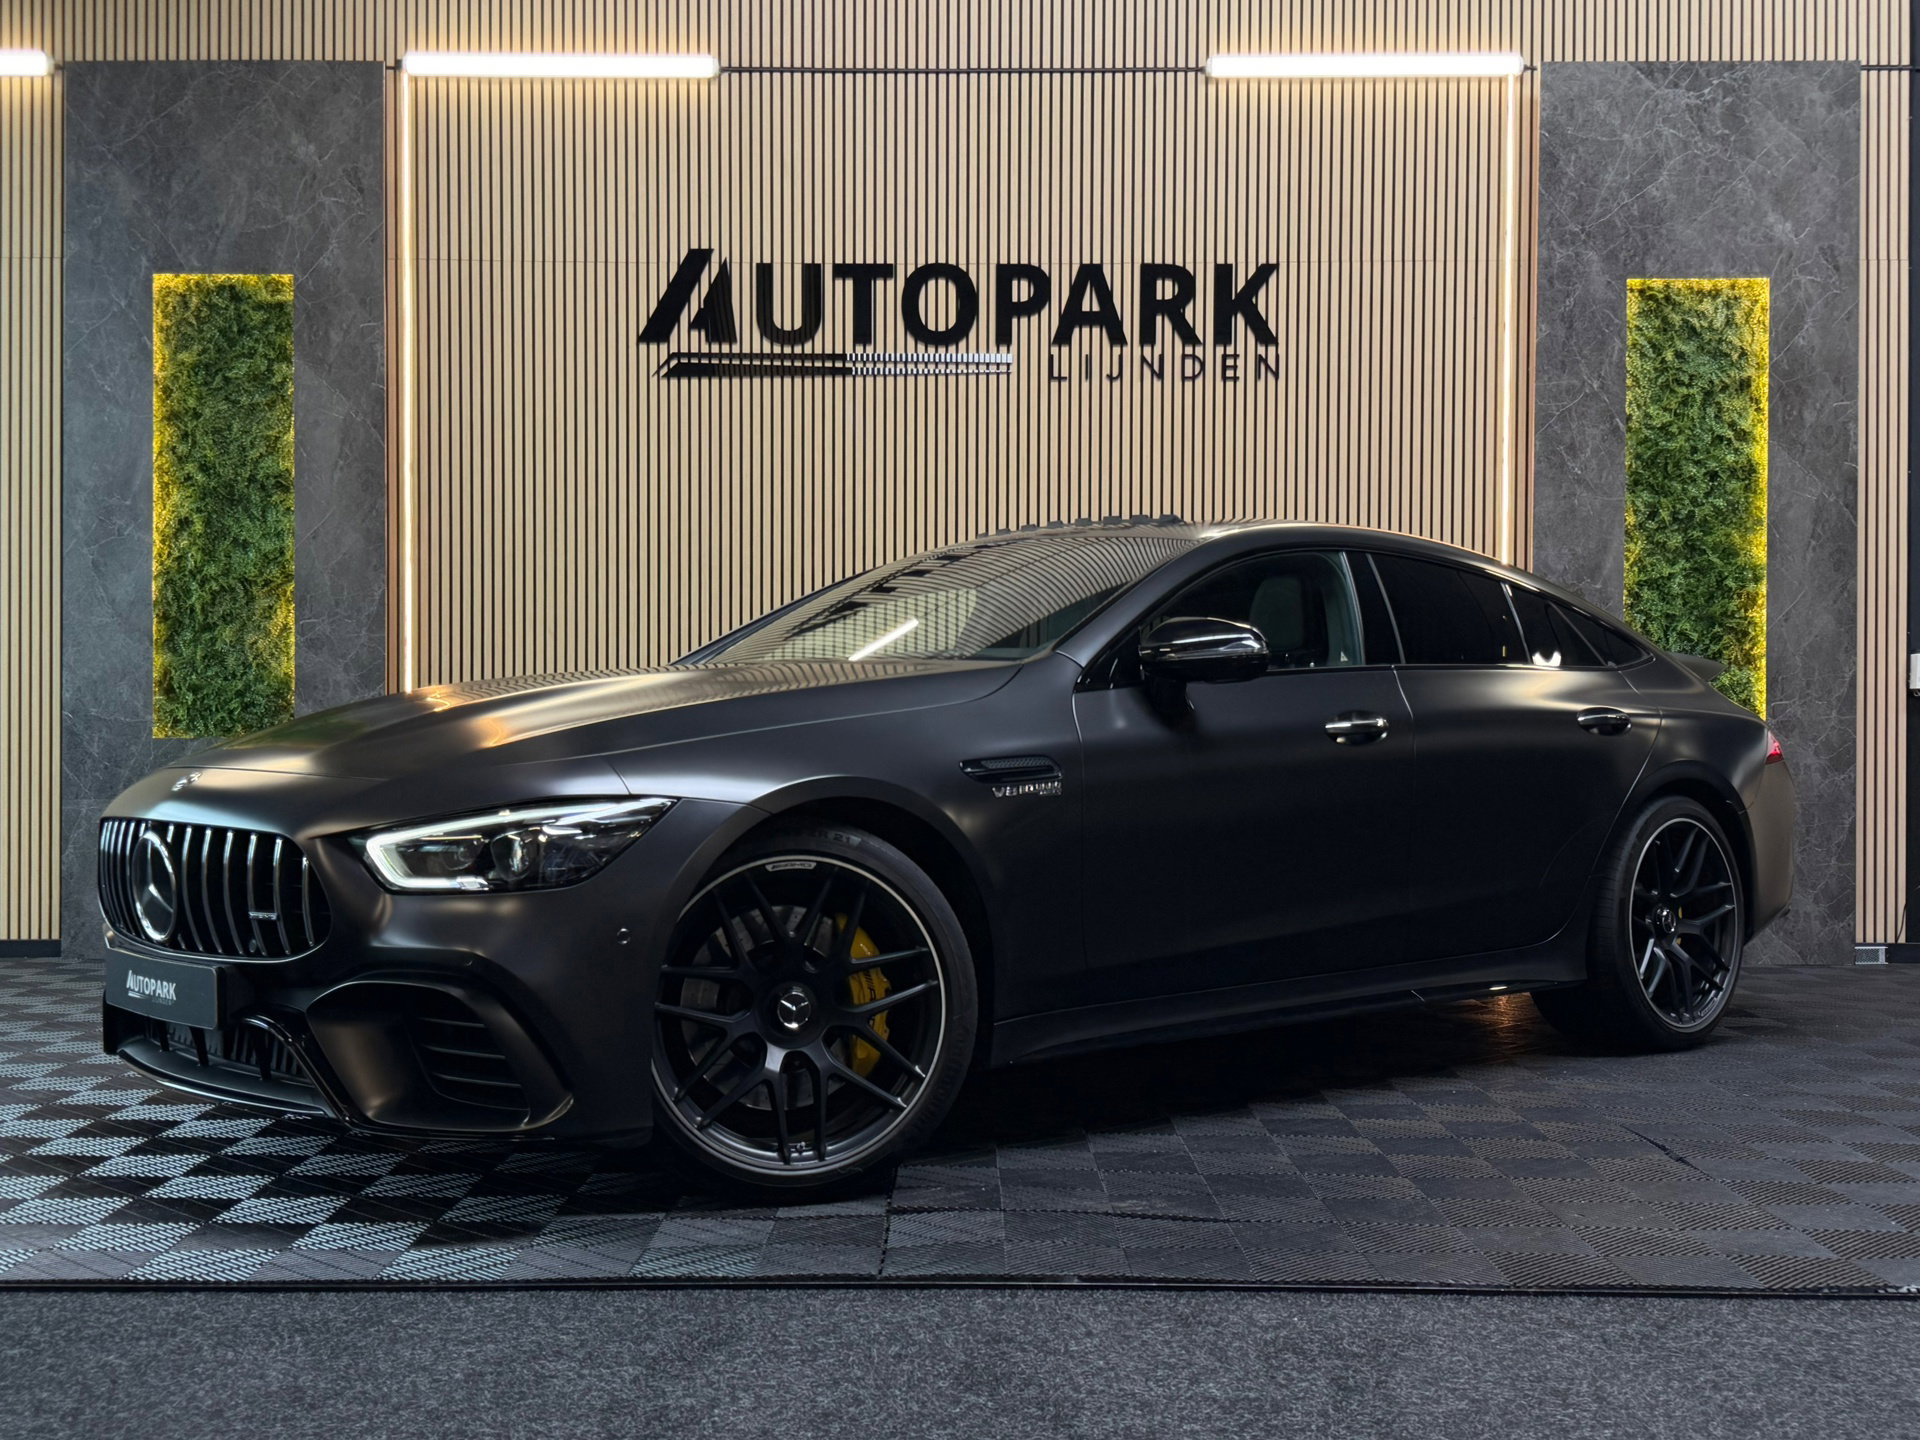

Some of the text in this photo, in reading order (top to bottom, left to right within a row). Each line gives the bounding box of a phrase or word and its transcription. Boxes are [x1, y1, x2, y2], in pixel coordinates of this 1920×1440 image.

[637, 248, 1280, 345] AUTOPARK
[1049, 353, 1280, 381] LIJNDEN
[126, 969, 177, 1000] AUTOPARK
